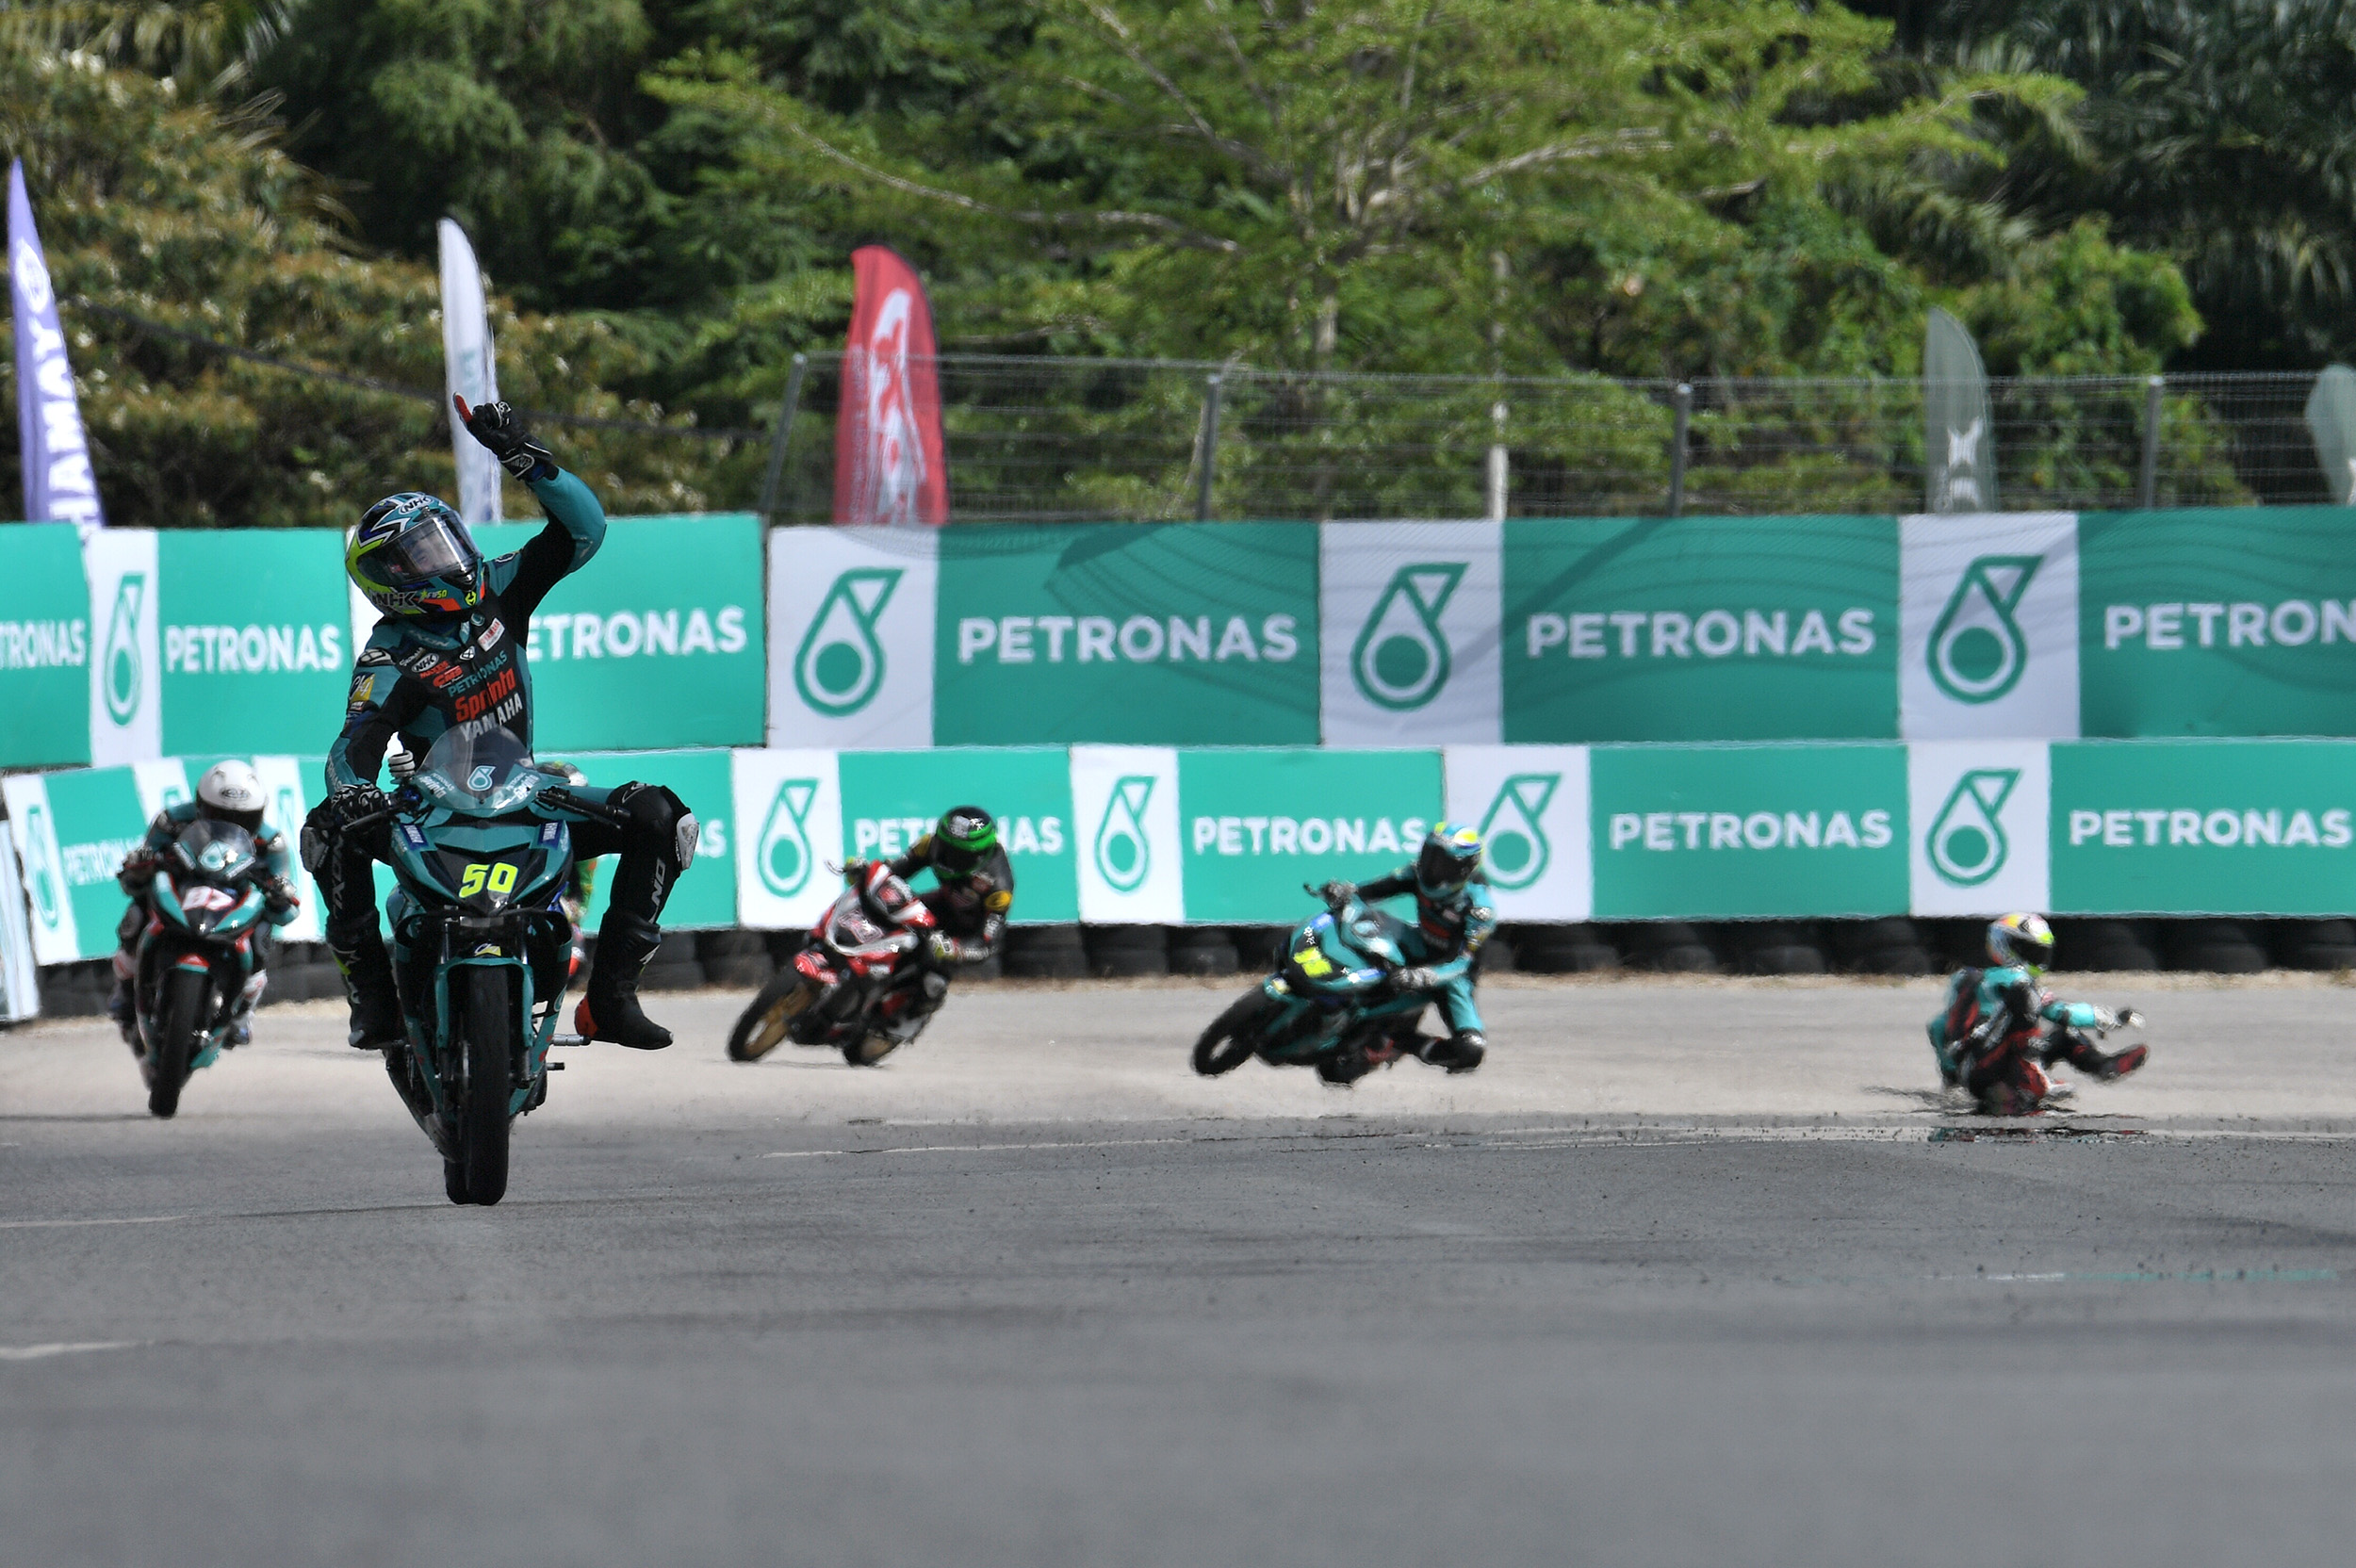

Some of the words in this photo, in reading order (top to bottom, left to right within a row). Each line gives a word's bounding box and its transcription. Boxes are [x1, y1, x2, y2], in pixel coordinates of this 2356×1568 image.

[527, 605, 747, 662] ETRONAS
[958, 614, 1299, 663] PETRONAS
[1528, 608, 1876, 657] PETRONAS
[2105, 600, 2356, 649] PETRON
[166, 624, 342, 672] PETRONAS
[416, 655, 434, 669] NHK
[448, 650, 507, 696] PETRONAS
[460, 693, 523, 742] YAMAHA
[855, 816, 1063, 856] PETNAS
[1193, 816, 1426, 856] PETRONAS
[1610, 808, 1892, 851] PETRONAS
[2070, 808, 2353, 847] PETRONAS
[459, 861, 518, 898] 50
